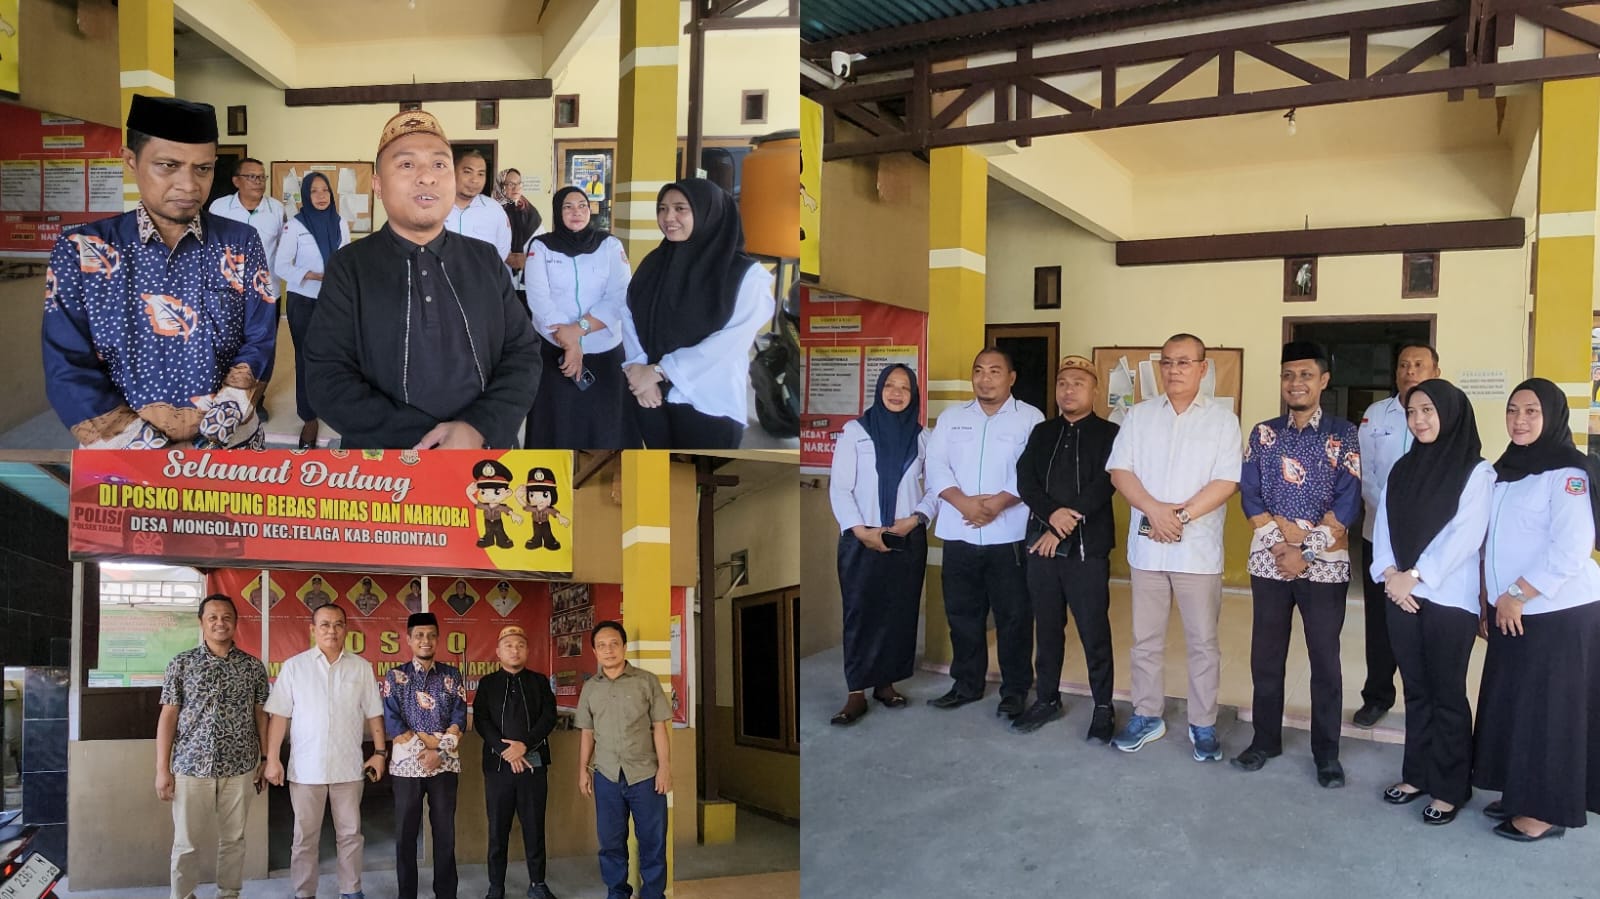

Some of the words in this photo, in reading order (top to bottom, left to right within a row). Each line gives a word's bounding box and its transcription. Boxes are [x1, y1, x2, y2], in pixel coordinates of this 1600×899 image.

[163, 450, 293, 484] Selamat
[300, 461, 414, 502] Datang
[74, 506, 123, 526] POLISI
[99, 484, 118, 507] DI
[121, 485, 179, 511] POSKO
[182, 488, 263, 515] KAMPUNG
[266, 494, 317, 519] BEBAS
[319, 498, 369, 522] MIRAS
[371, 502, 401, 523] DAN
[403, 504, 470, 528] NARKOBA
[130, 516, 168, 532] DESA
[172, 518, 258, 537] MONGOLATO
[263, 523, 341, 541] KEC.TELAGA
[344, 528, 448, 547] KAB.GORONTALO
